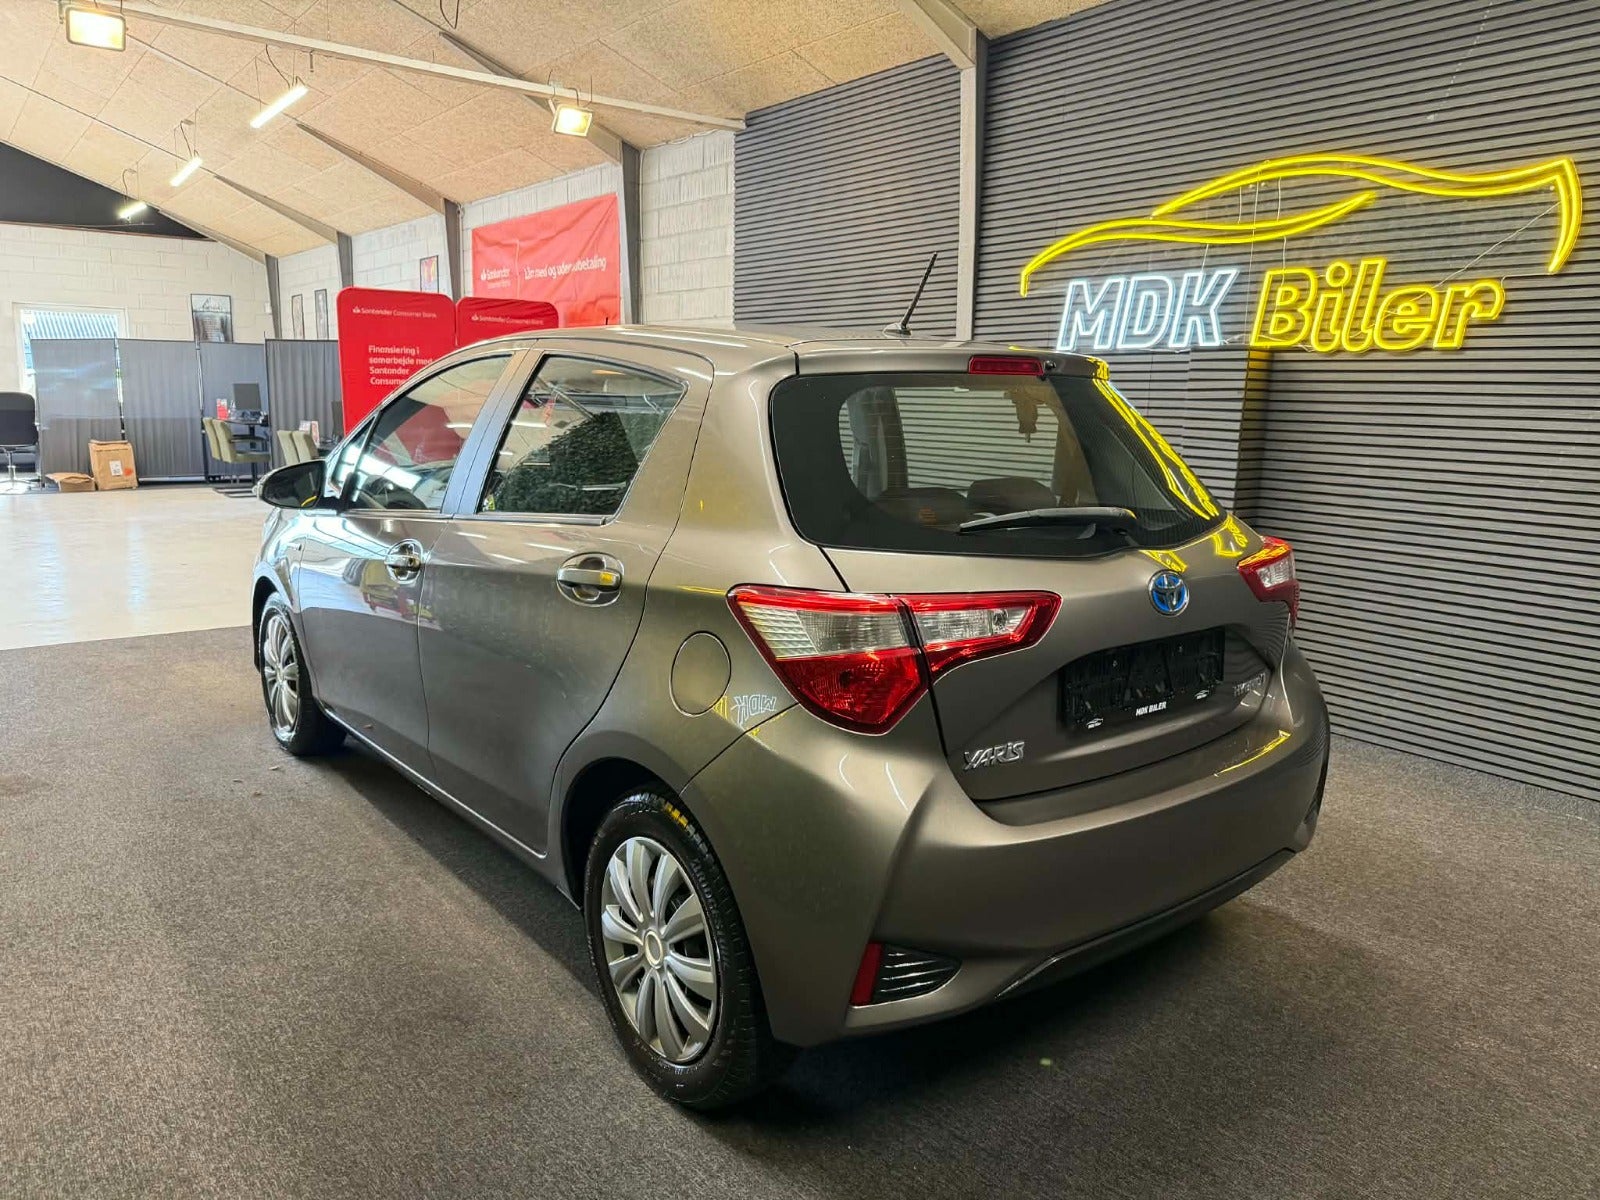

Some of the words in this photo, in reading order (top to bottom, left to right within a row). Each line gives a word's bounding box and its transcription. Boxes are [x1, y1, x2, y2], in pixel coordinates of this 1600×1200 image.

[1056, 266, 1240, 353] MDK
[1249, 257, 1506, 353] Biler
[361, 307, 393, 316] Santander
[368, 345, 415, 356] Finansiering
[369, 356, 415, 366] samarbejde
[369, 366, 409, 375] Santander
[1135, 706, 1148, 717] MDK
[962, 741, 1025, 770] YARIS
